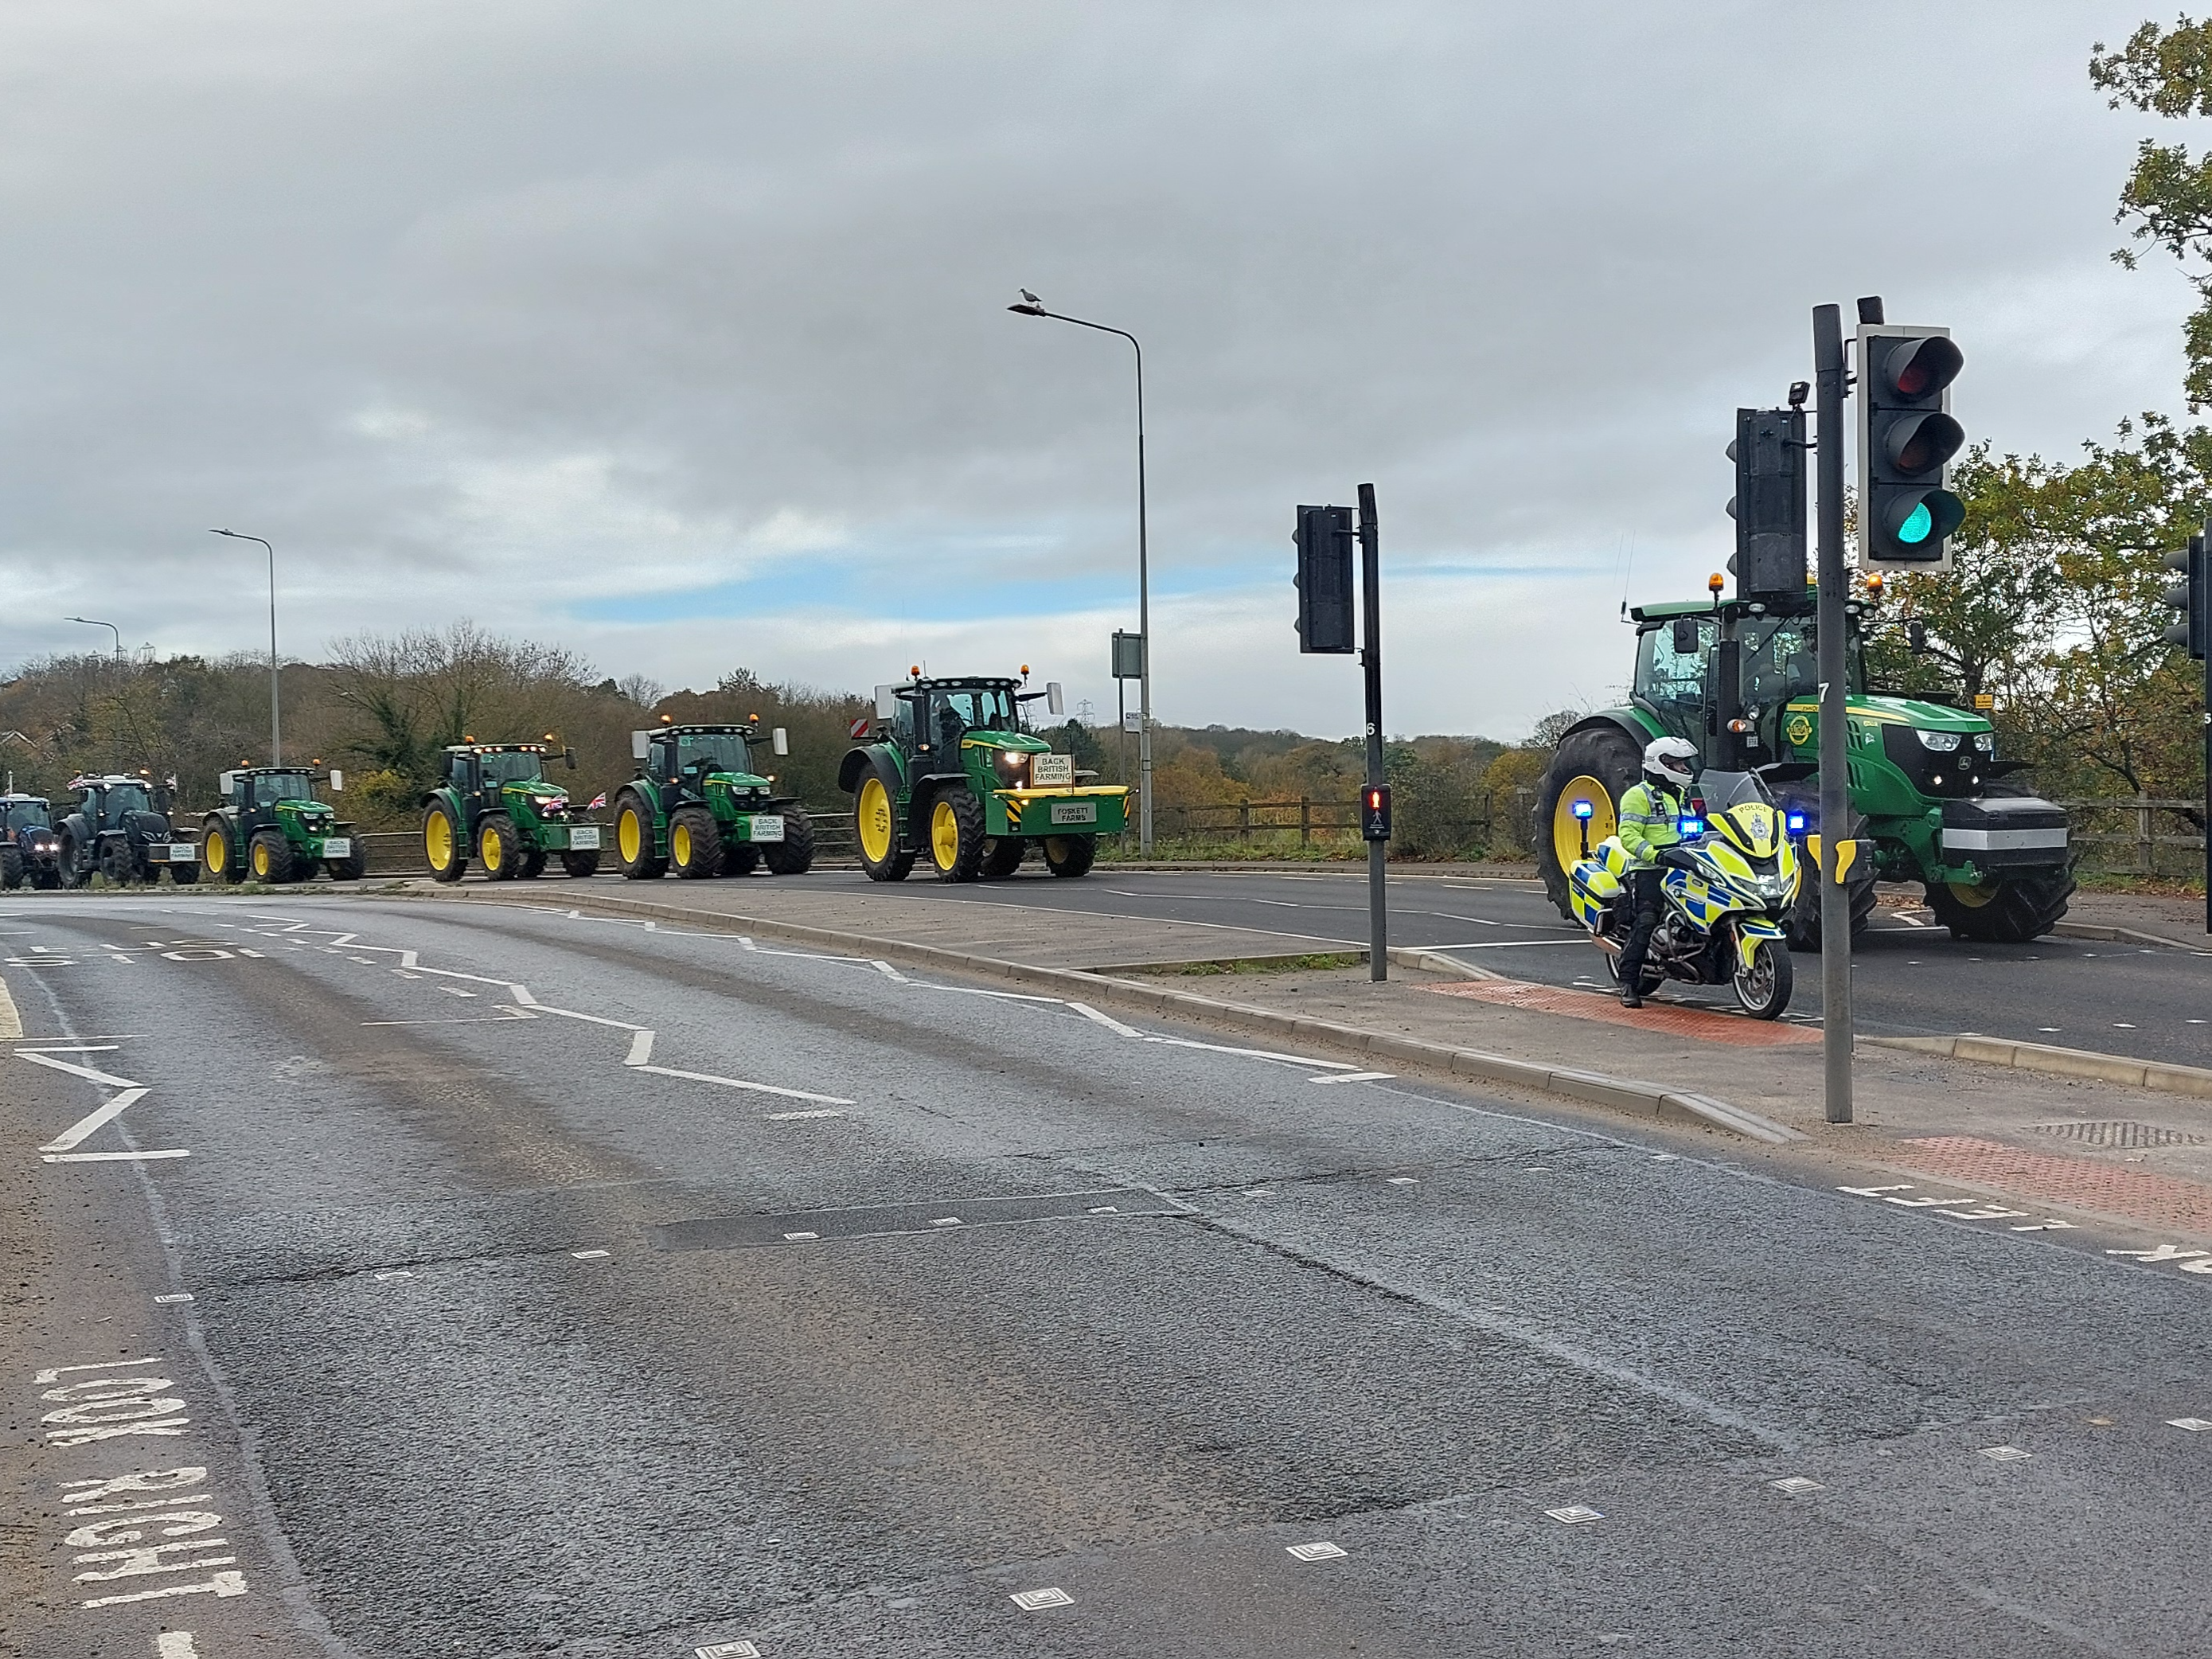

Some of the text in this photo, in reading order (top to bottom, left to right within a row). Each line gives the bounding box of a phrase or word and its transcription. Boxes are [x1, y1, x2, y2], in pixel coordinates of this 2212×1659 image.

[1819, 682, 1829, 703] 7
[1367, 722, 1375, 735] 6
[1035, 772, 1071, 781] FARMING
[1738, 804, 1768, 813] POLICE
[1836, 1185, 2081, 1231] LEFT
[33, 1357, 248, 1609] LOOK RIGHT
